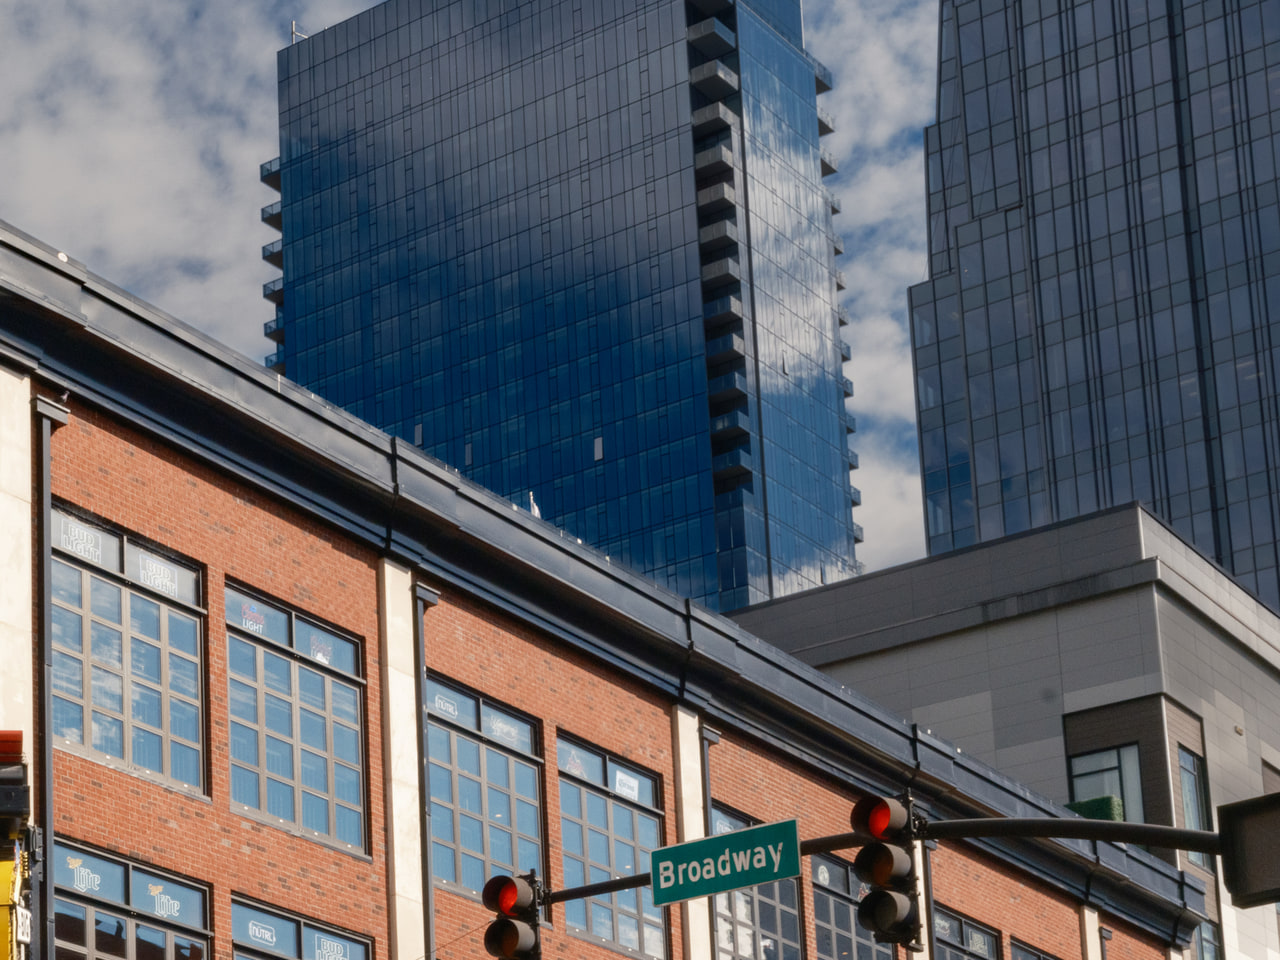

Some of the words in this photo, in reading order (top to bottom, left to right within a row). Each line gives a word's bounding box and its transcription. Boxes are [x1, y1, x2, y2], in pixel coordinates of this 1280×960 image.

[68, 523, 96, 545] BUD
[63, 534, 100, 563] LIGHT
[145, 559, 172, 580] BUD
[141, 569, 177, 597] LIGHT
[242, 617, 264, 634] LIGHT
[659, 842, 784, 889] Broadway
[73, 865, 101, 893] Lite
[154, 892, 180, 917] Lite
[321, 938, 344, 957] BUD
